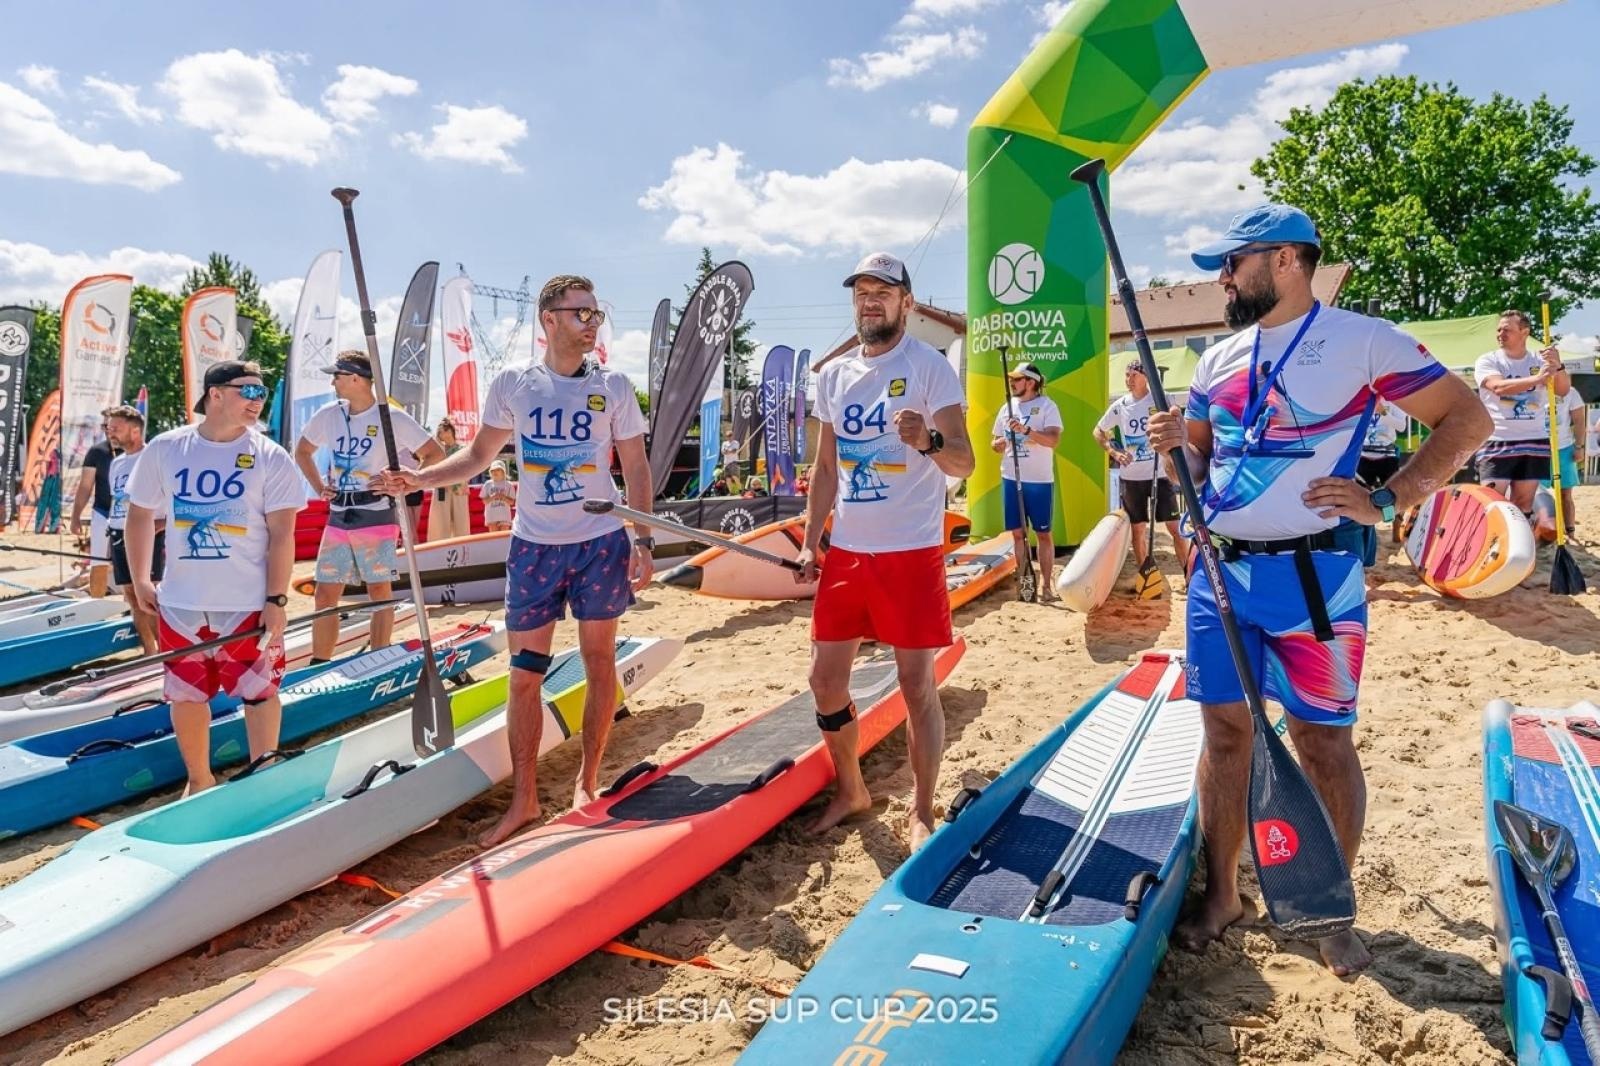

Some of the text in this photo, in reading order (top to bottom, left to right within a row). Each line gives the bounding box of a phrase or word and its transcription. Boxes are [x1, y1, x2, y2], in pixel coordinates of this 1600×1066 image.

[994, 250, 1037, 298] DG
[700, 275, 726, 299] PADDLE
[972, 310, 1067, 336] DĄBROWA
[972, 330, 1067, 354] GÓRNICZA
[1015, 350, 1068, 362] aktywnych
[528, 407, 592, 441] 118
[843, 401, 887, 436] 84
[336, 436, 372, 456] 129
[174, 467, 245, 499] 106
[47, 615, 61, 627] NSP
[623, 667, 636, 688] NSP
